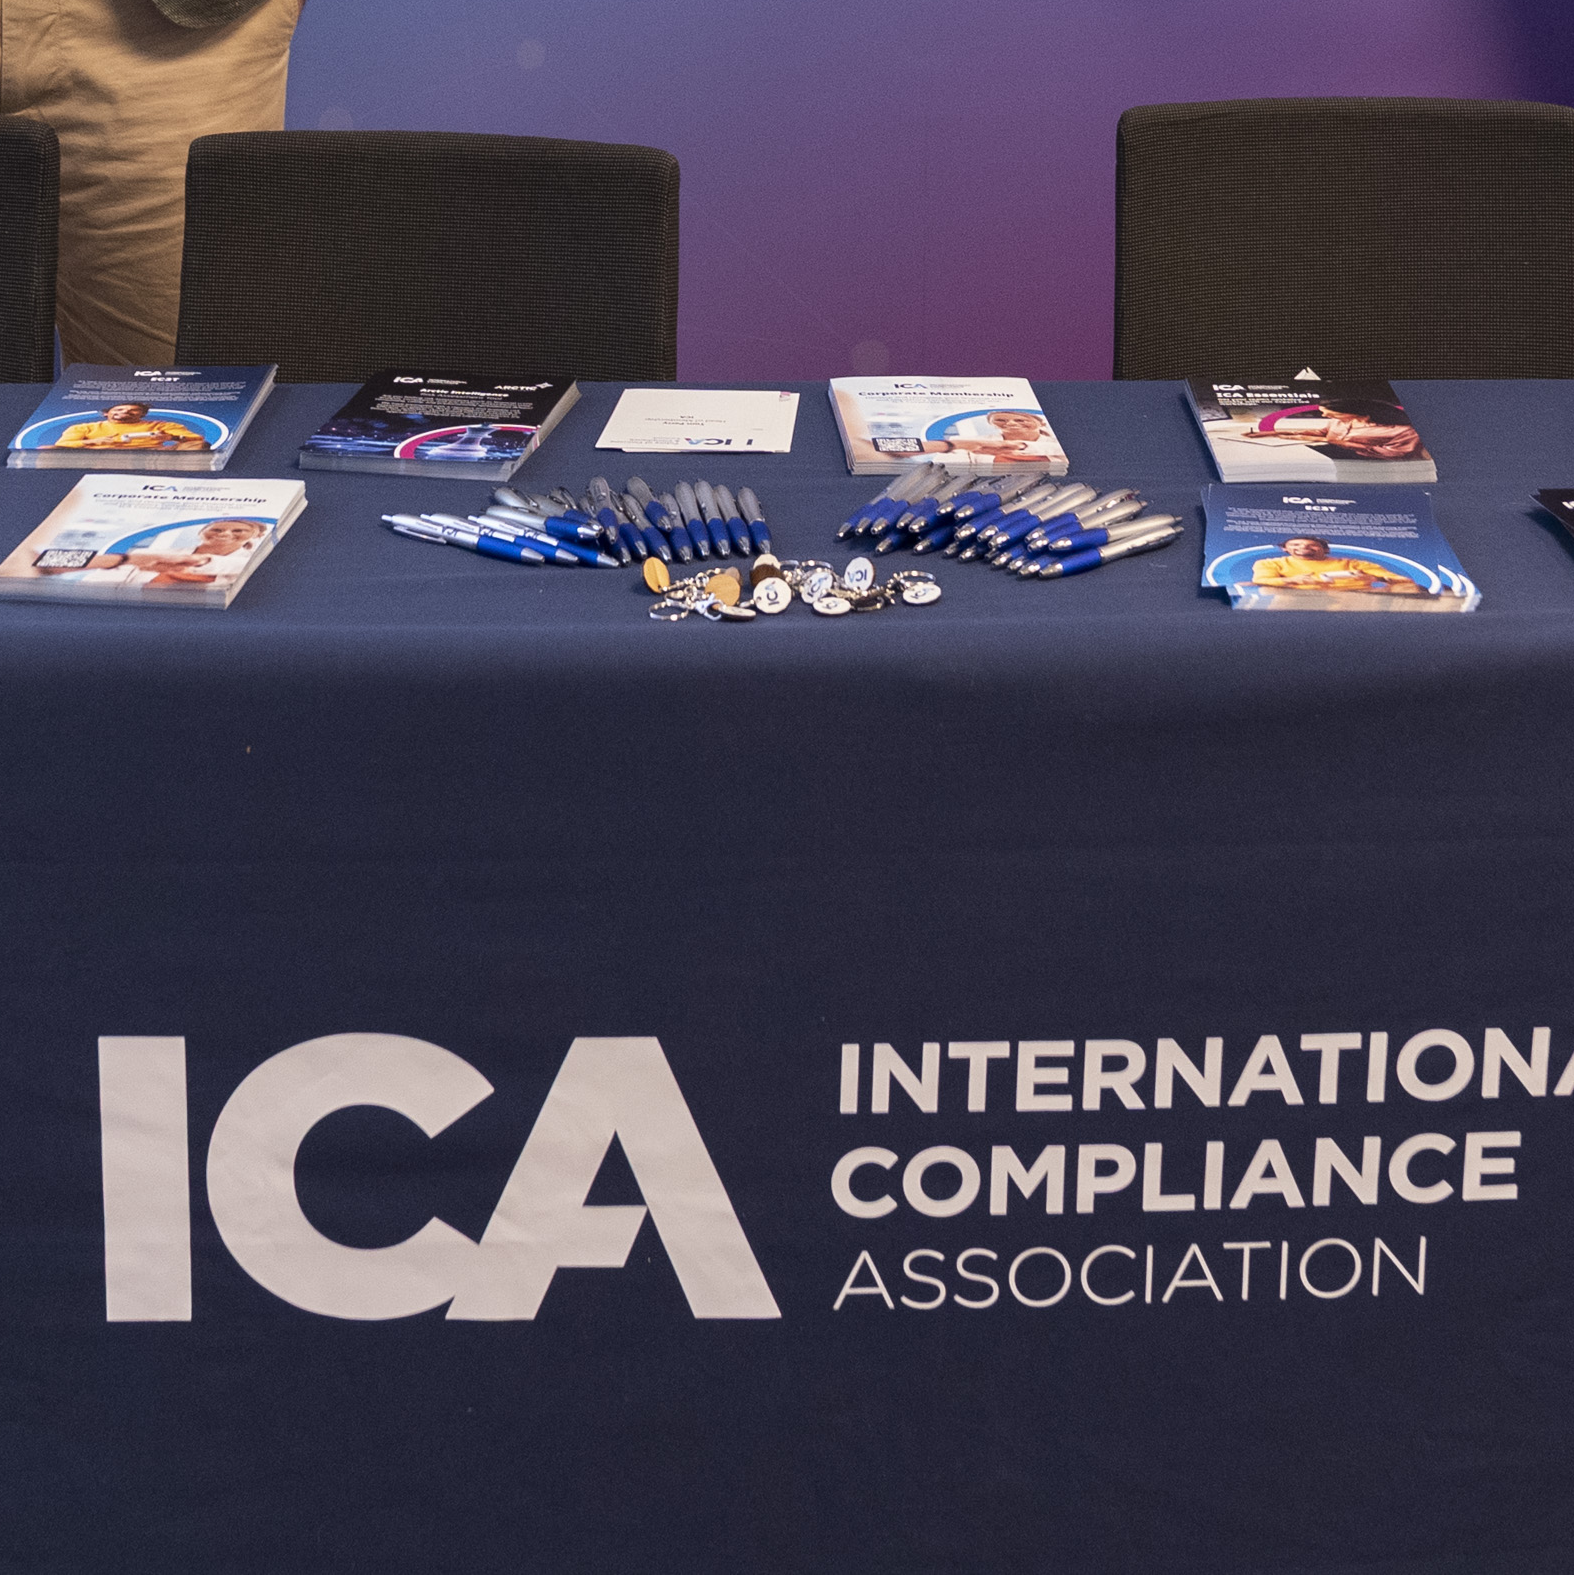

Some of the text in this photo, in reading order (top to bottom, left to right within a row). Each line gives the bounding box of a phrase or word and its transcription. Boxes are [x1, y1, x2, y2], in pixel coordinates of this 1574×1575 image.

[172, 495, 267, 504] Membership
[98, 1032, 782, 1323] ICA
[831, 1131, 1521, 1219] COMPLIANCE
[834, 1237, 1427, 1312] ASSOCIATION
